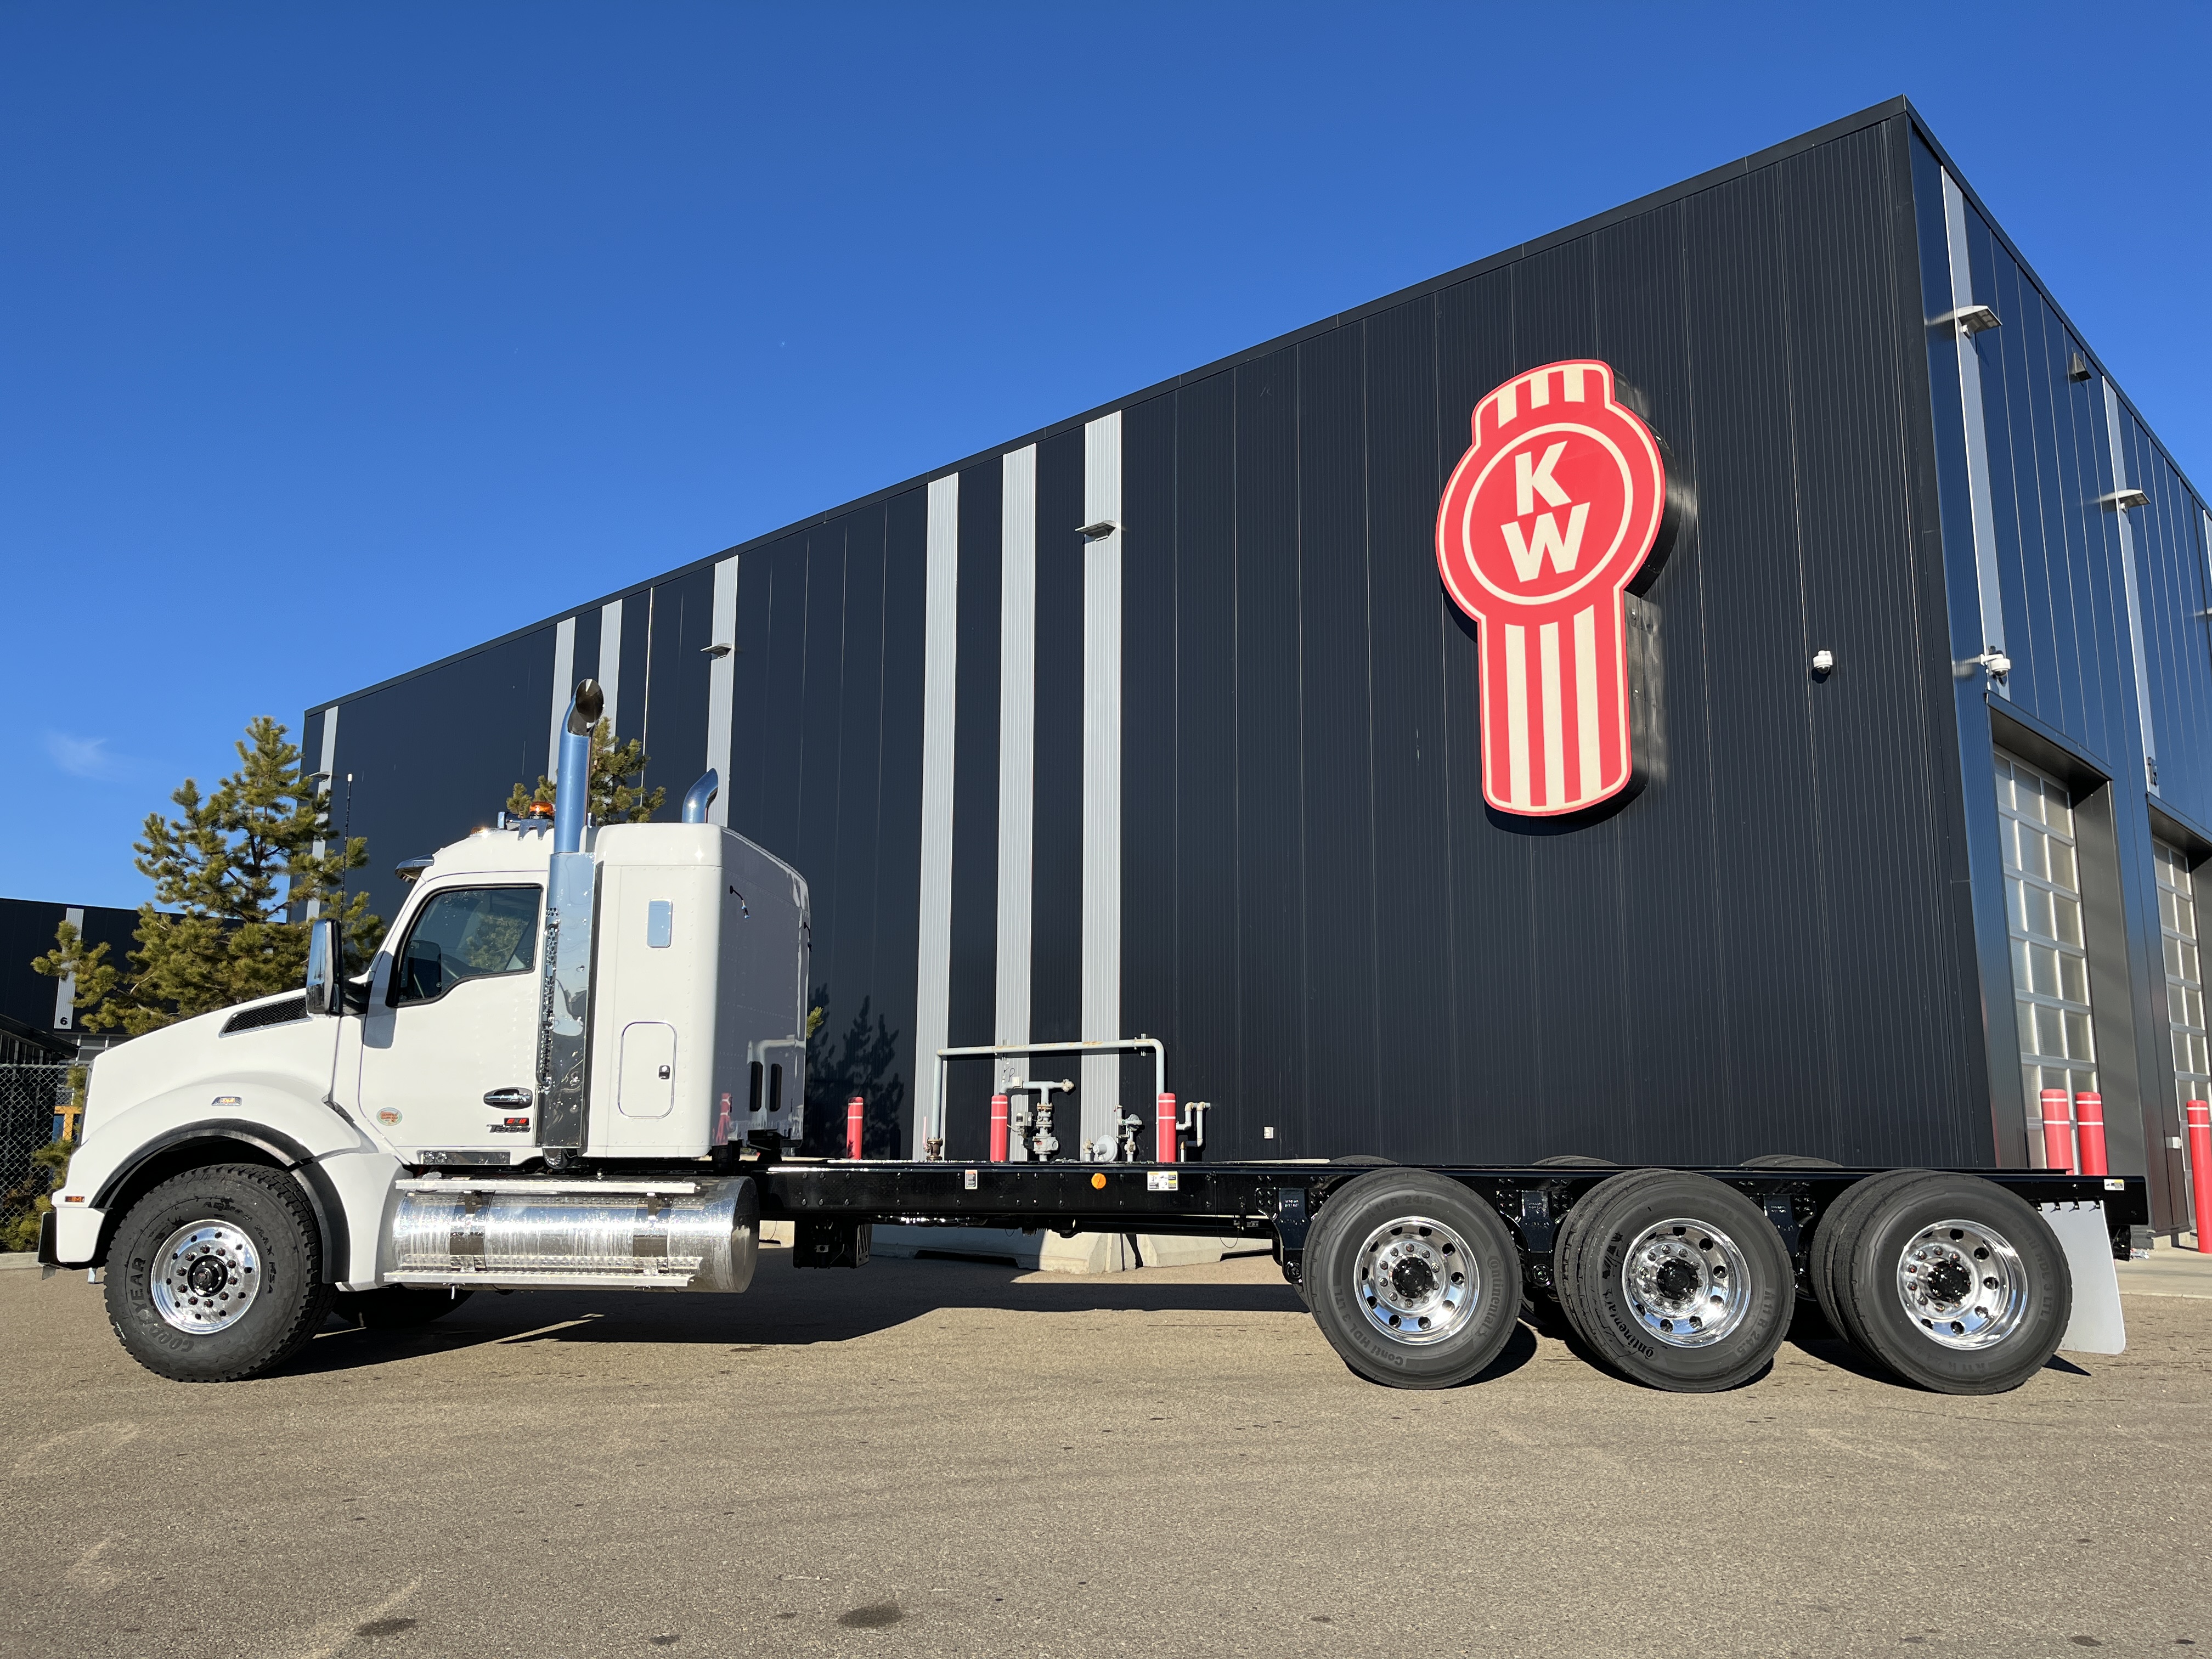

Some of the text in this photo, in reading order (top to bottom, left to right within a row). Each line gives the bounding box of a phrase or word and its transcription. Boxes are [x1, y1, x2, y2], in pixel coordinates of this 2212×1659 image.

[60, 1017, 68, 1025] 6
[1404, 1195, 1432, 1205] 24.5
[1481, 1256, 1503, 1330] Continental
[1334, 1289, 1403, 1366] Conti HDL 3 LTL
[1737, 1330, 1760, 1356] 24.5
